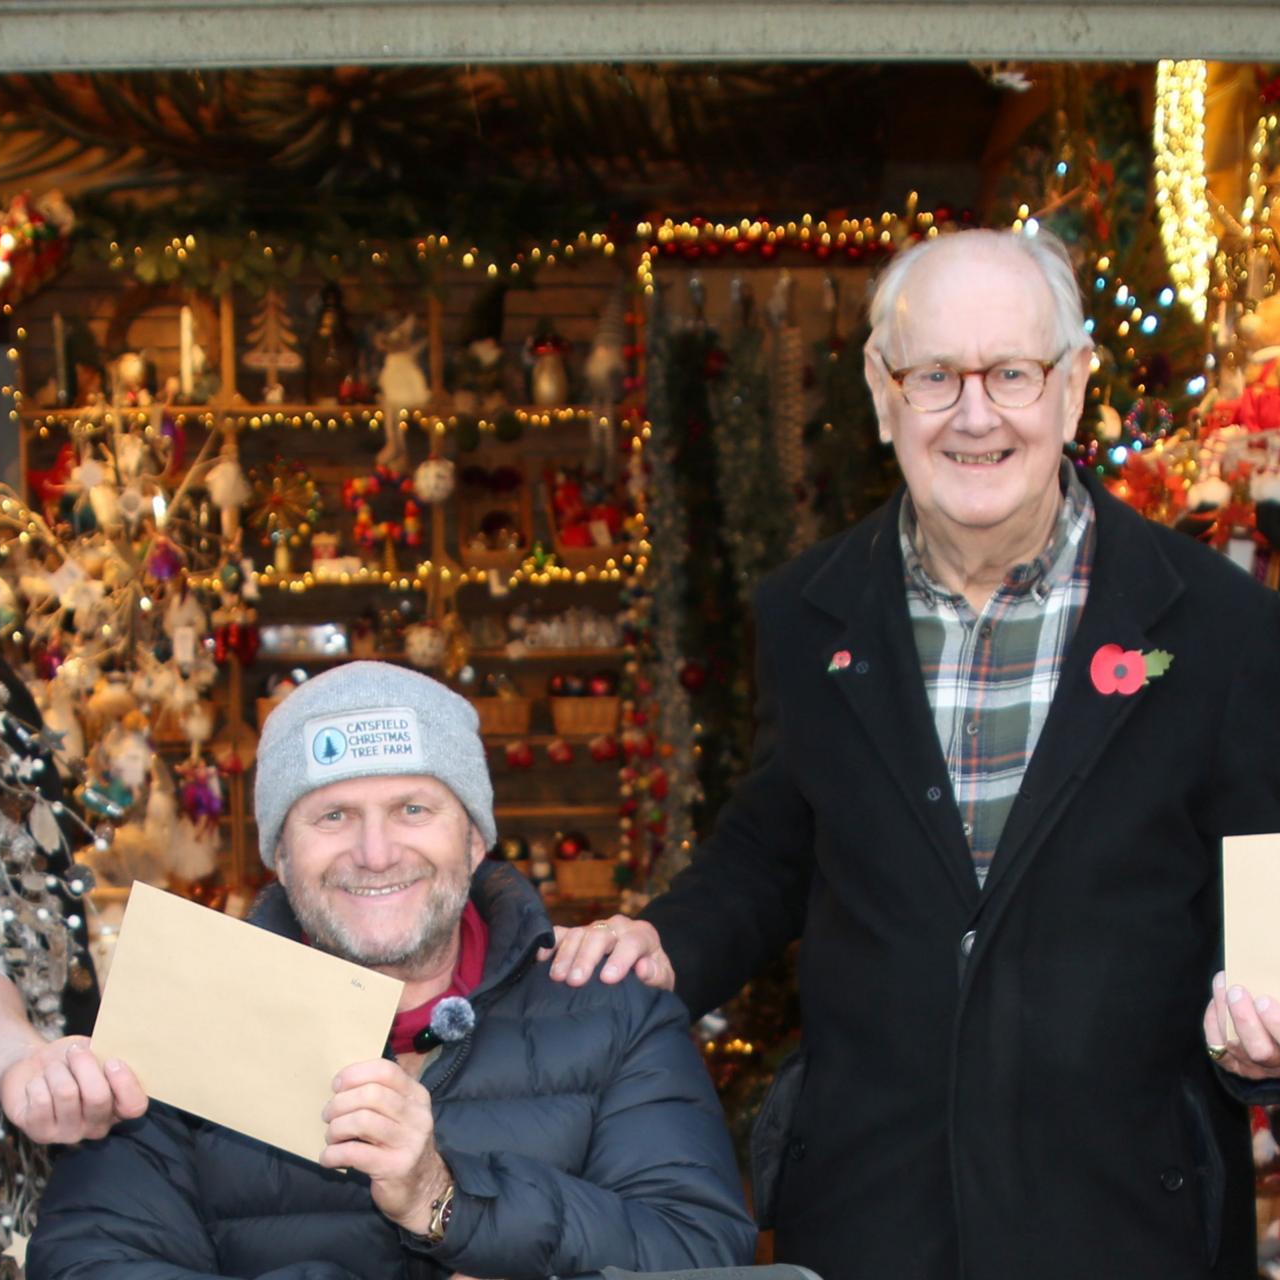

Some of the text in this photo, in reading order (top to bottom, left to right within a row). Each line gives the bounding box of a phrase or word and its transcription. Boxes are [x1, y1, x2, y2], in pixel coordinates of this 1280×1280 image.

[346, 719, 408, 734] CATSFIELD
[348, 731, 411, 746] CHRISTMAS
[350, 743, 413, 758] TREE FARM
